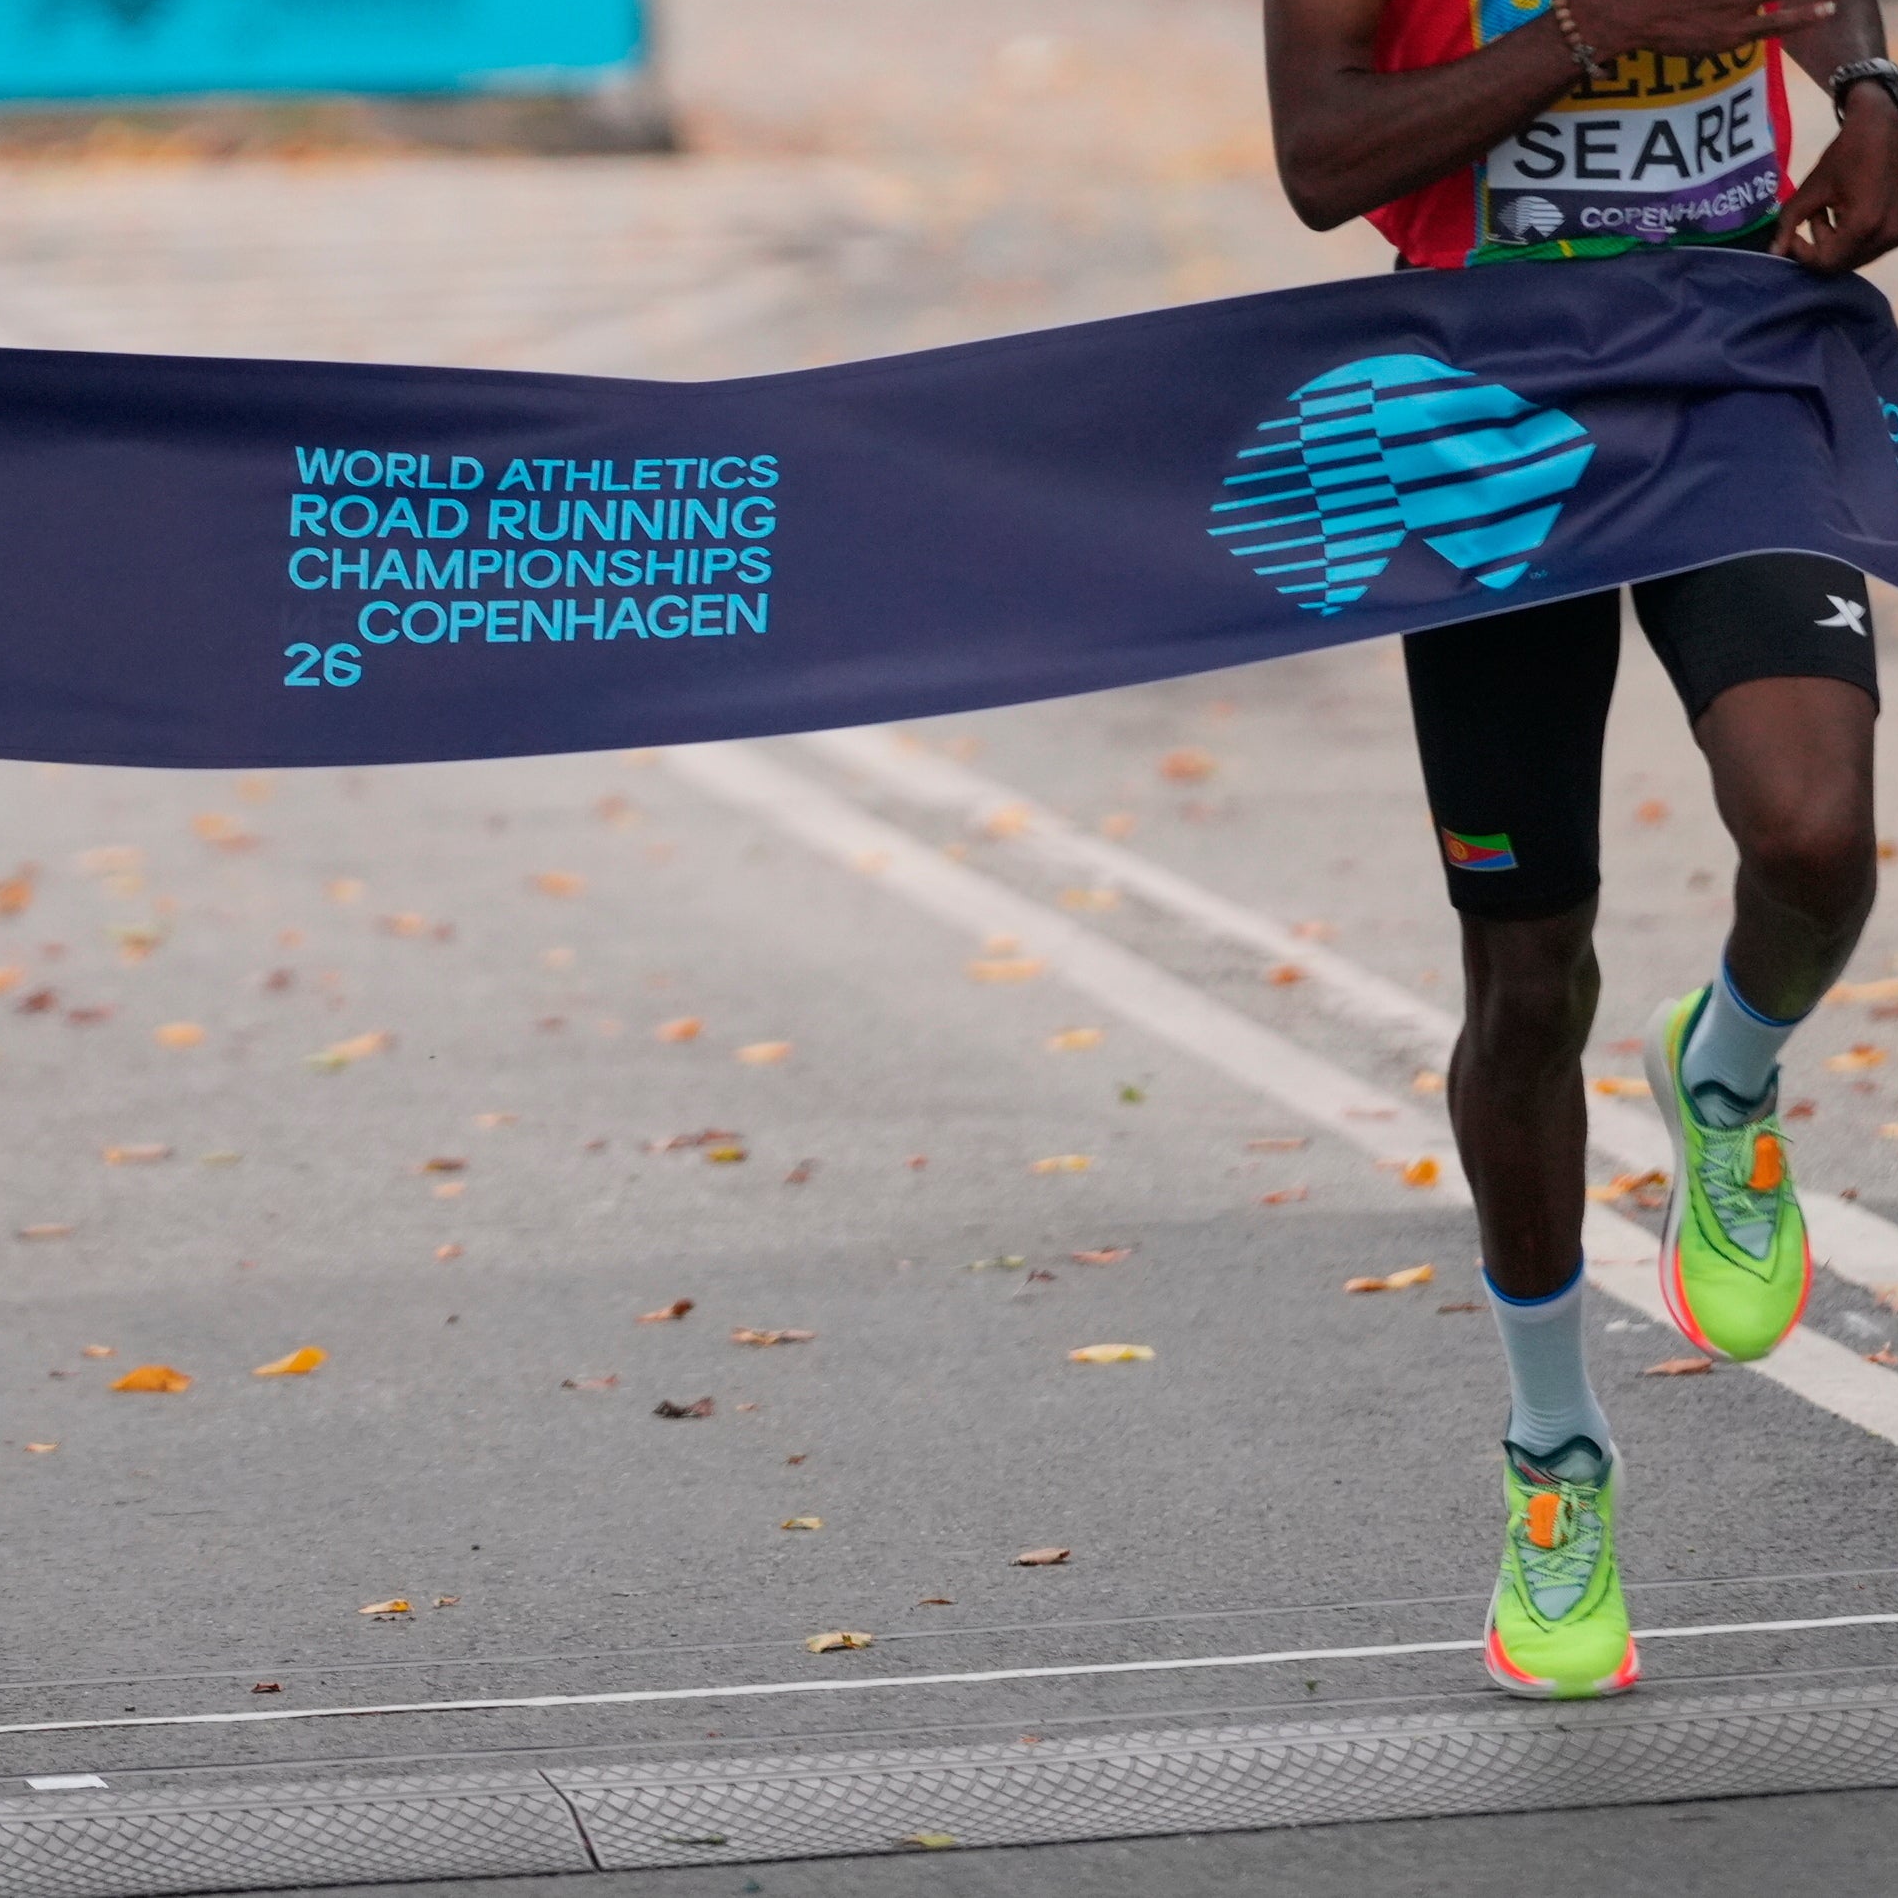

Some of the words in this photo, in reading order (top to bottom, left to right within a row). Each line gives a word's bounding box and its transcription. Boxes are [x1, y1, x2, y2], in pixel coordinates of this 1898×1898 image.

[1513, 88, 1754, 181] SEARE
[1580, 181, 1753, 229] COPENHAGEN
[1752, 170, 1781, 201] 26
[295, 446, 485, 490] WORLD
[496, 454, 780, 492] ATHLETICS
[289, 493, 470, 539] ROAD
[487, 495, 777, 542] RUNNING
[288, 545, 772, 591] CHAMPIONSHIPS
[357, 592, 769, 645] COPENHAGEN
[283, 642, 362, 688] 26
